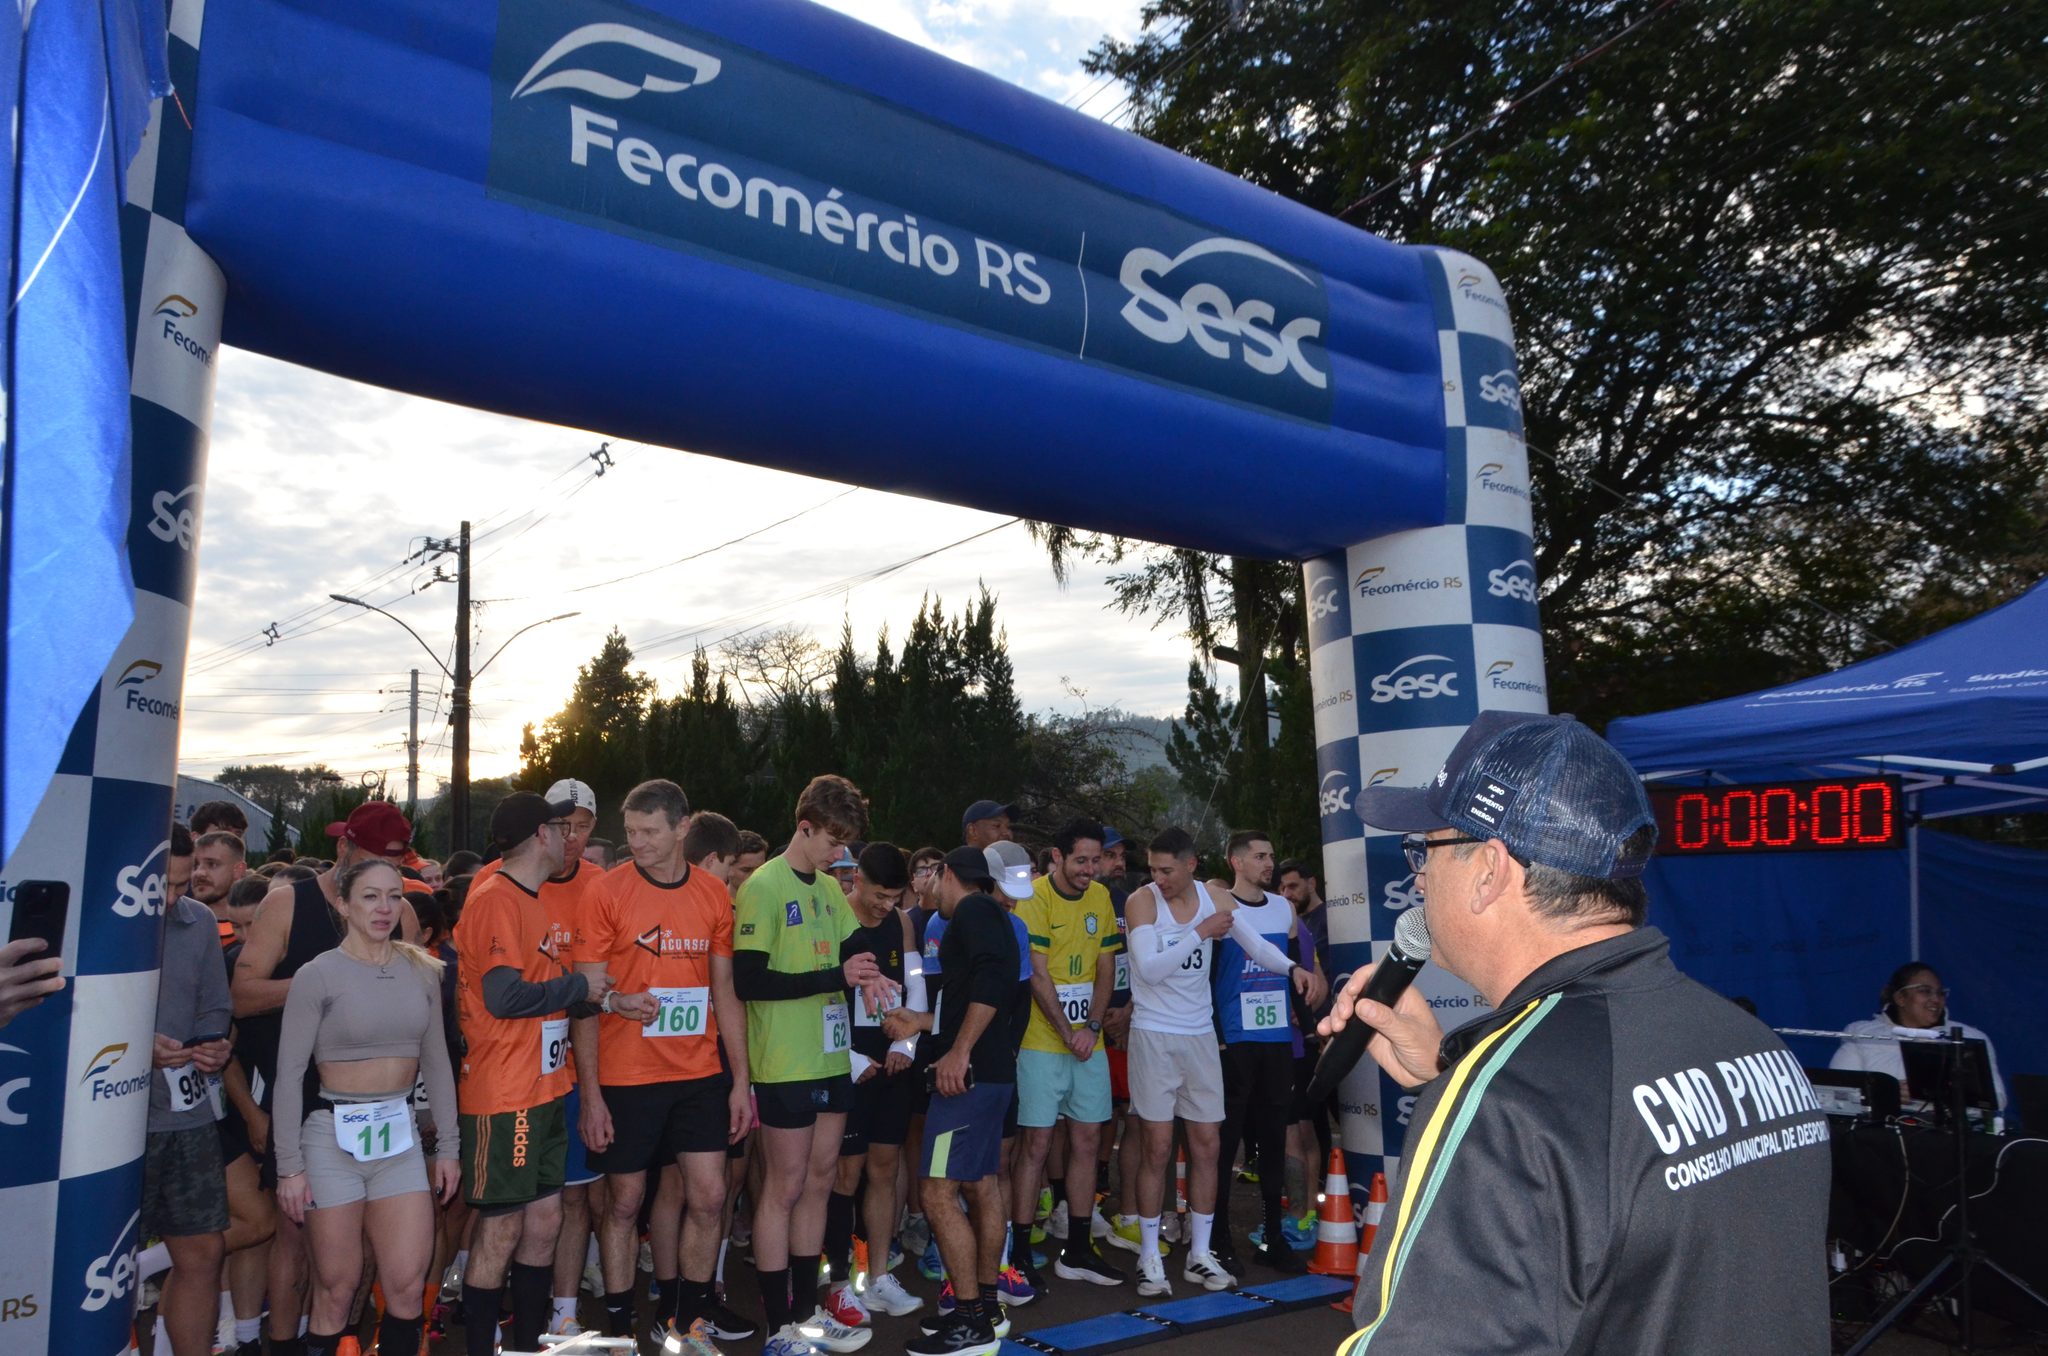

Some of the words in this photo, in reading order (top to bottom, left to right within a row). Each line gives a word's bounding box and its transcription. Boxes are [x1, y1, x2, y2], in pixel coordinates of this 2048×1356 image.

[570, 104, 960, 276] Fecomércio
[975, 237, 1051, 305] RS
[1120, 236, 1327, 390] Sesc
[1360, 579, 1439, 598] Fecomércio
[1443, 577, 1462, 588] RS
[1370, 654, 1459, 703] Sesc
[1339, 689, 1353, 703] RS
[1351, 893, 1366, 905] RS
[1069, 954, 1082, 977] 10
[658, 1005, 699, 1032] 160
[1255, 1006, 1277, 1026] 85
[833, 1022, 846, 1048] 62
[1364, 1103, 1378, 1116] RS
[1632, 1067, 1728, 1155] CMD
[357, 1122, 390, 1156] 11
[1664, 1146, 1733, 1191] CONSELHO
[1731, 1131, 1782, 1166] MUNICIPAL
[1782, 1127, 1798, 1151] DE
[2, 1294, 38, 1322] RS
